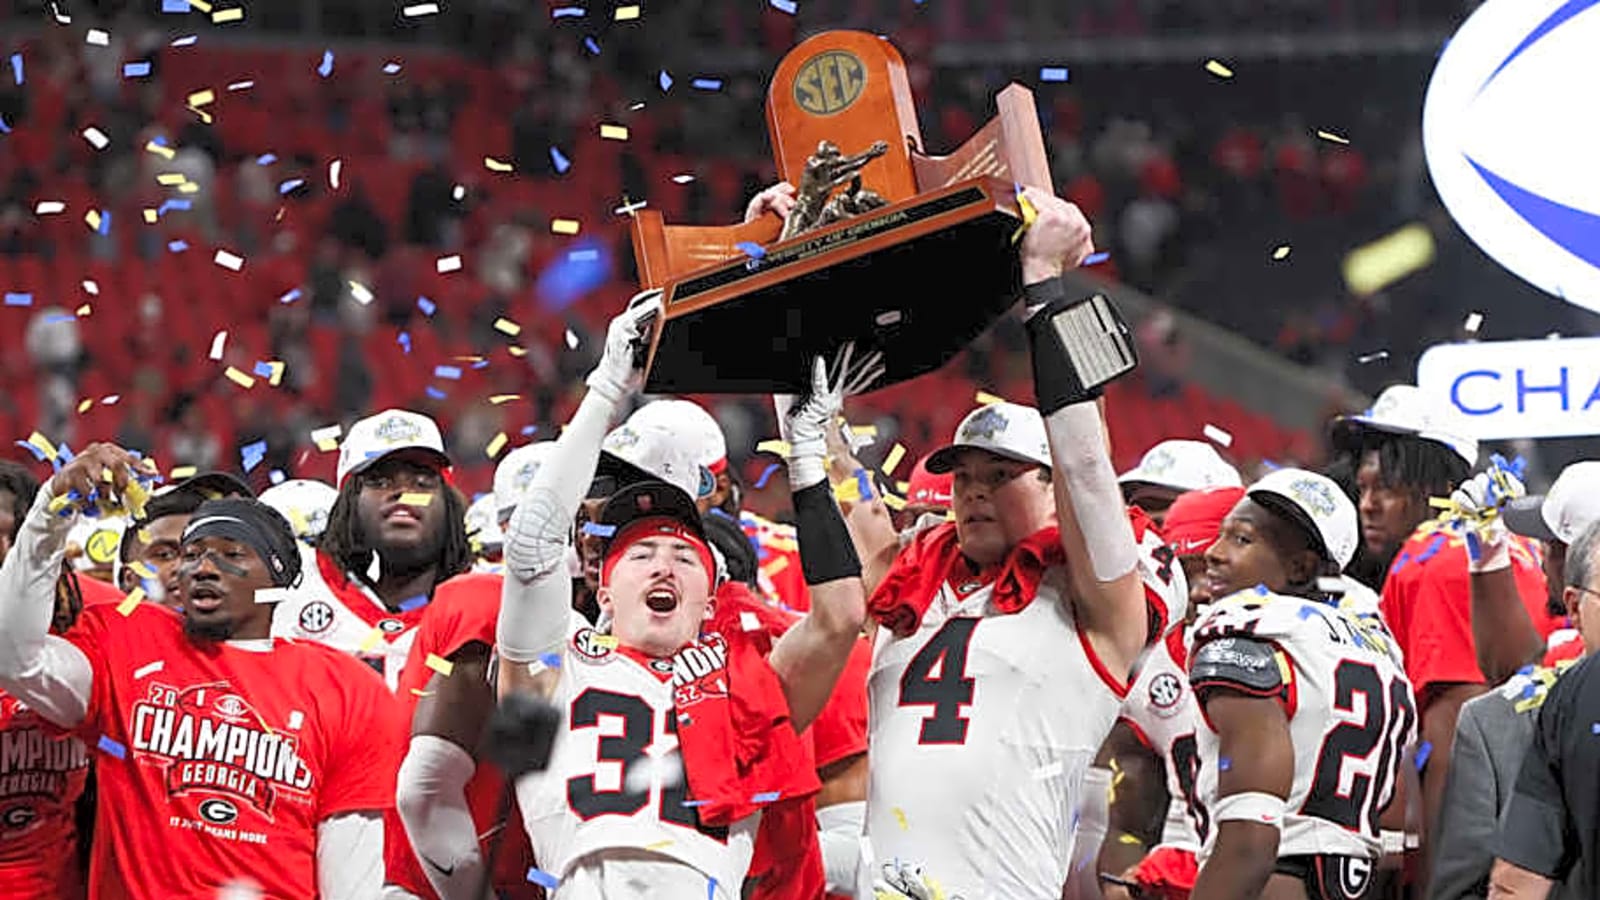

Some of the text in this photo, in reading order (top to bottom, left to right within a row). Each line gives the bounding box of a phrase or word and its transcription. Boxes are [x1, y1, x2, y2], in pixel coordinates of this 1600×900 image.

[796, 54, 862, 112] SEC
[301, 603, 332, 631] SEC
[898, 615, 979, 745] 4
[1151, 675, 1180, 706] SEC
[134, 702, 311, 790] CHAMPIONS
[1299, 657, 1418, 838] 20
[182, 763, 256, 798] GEORGIA
[201, 800, 237, 823] G
[239, 830, 268, 844] MORE
[1341, 858, 1371, 896] G
